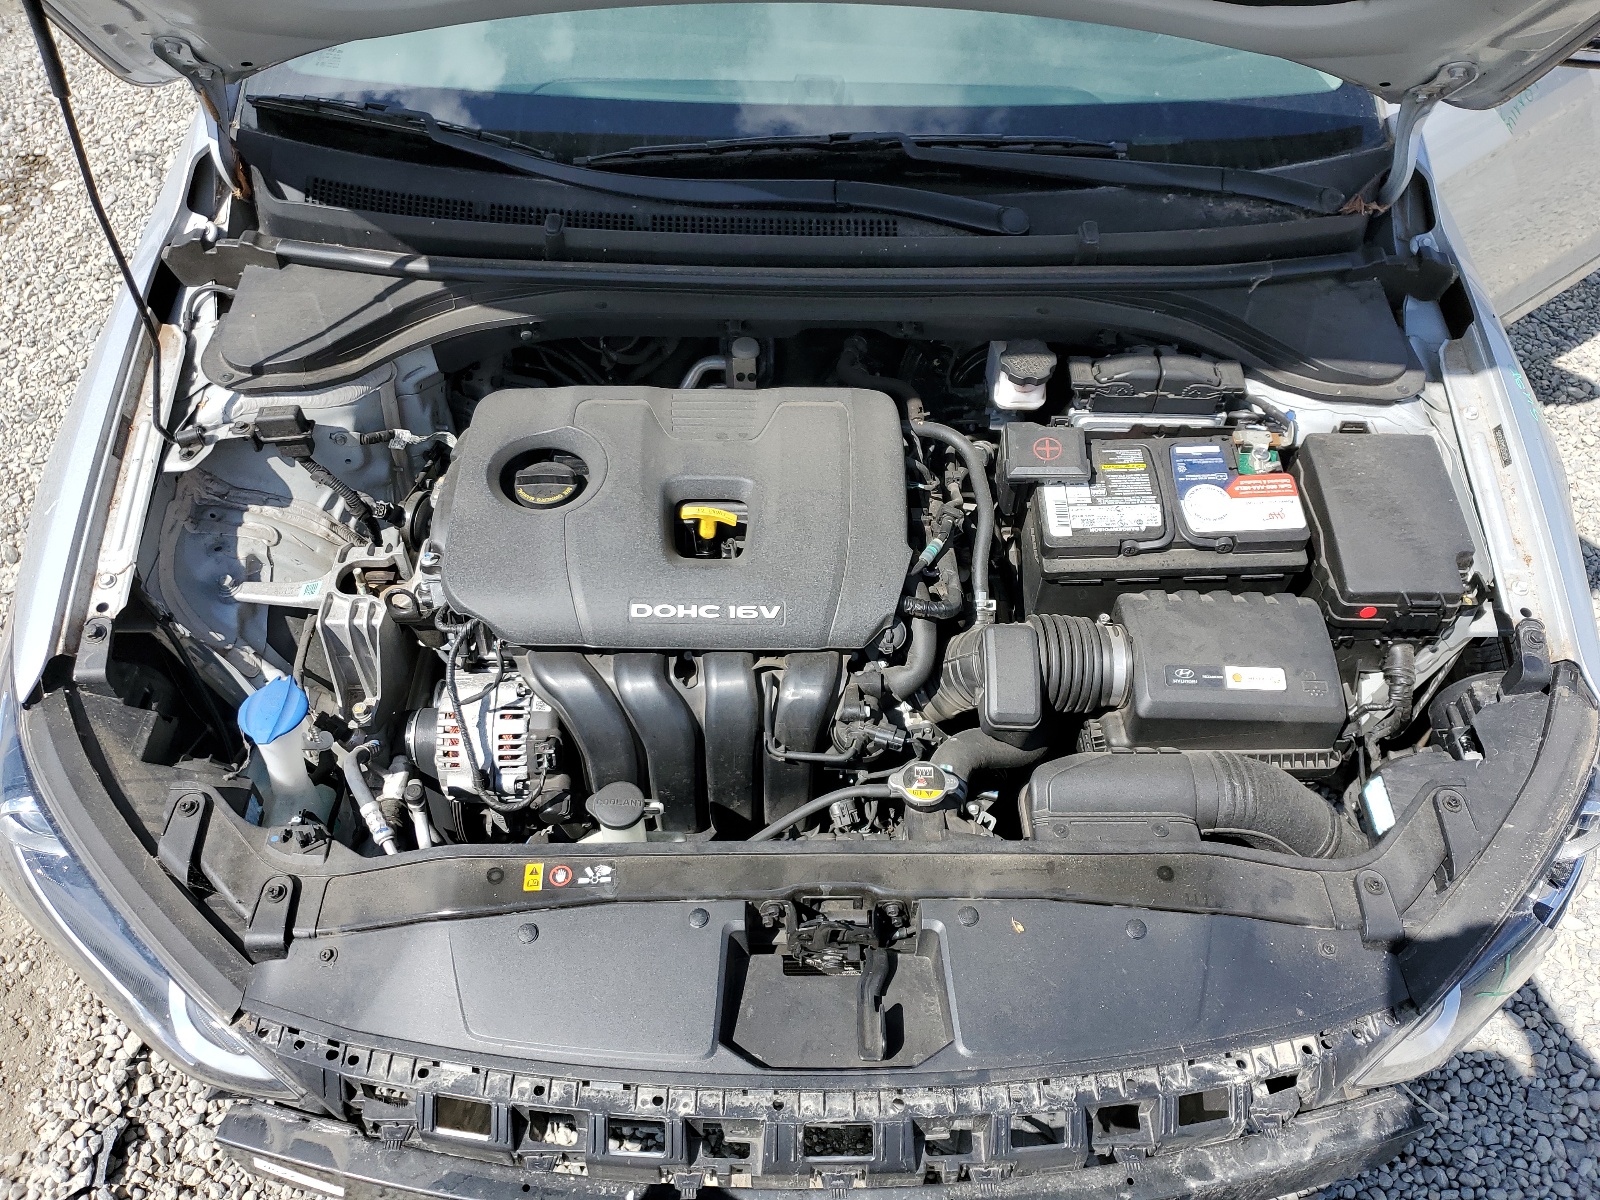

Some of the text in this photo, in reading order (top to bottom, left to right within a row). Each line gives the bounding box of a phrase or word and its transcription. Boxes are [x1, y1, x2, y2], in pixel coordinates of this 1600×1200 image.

[630, 603, 781, 619] DOHC 16V
[596, 798, 643, 807] COOLANT
